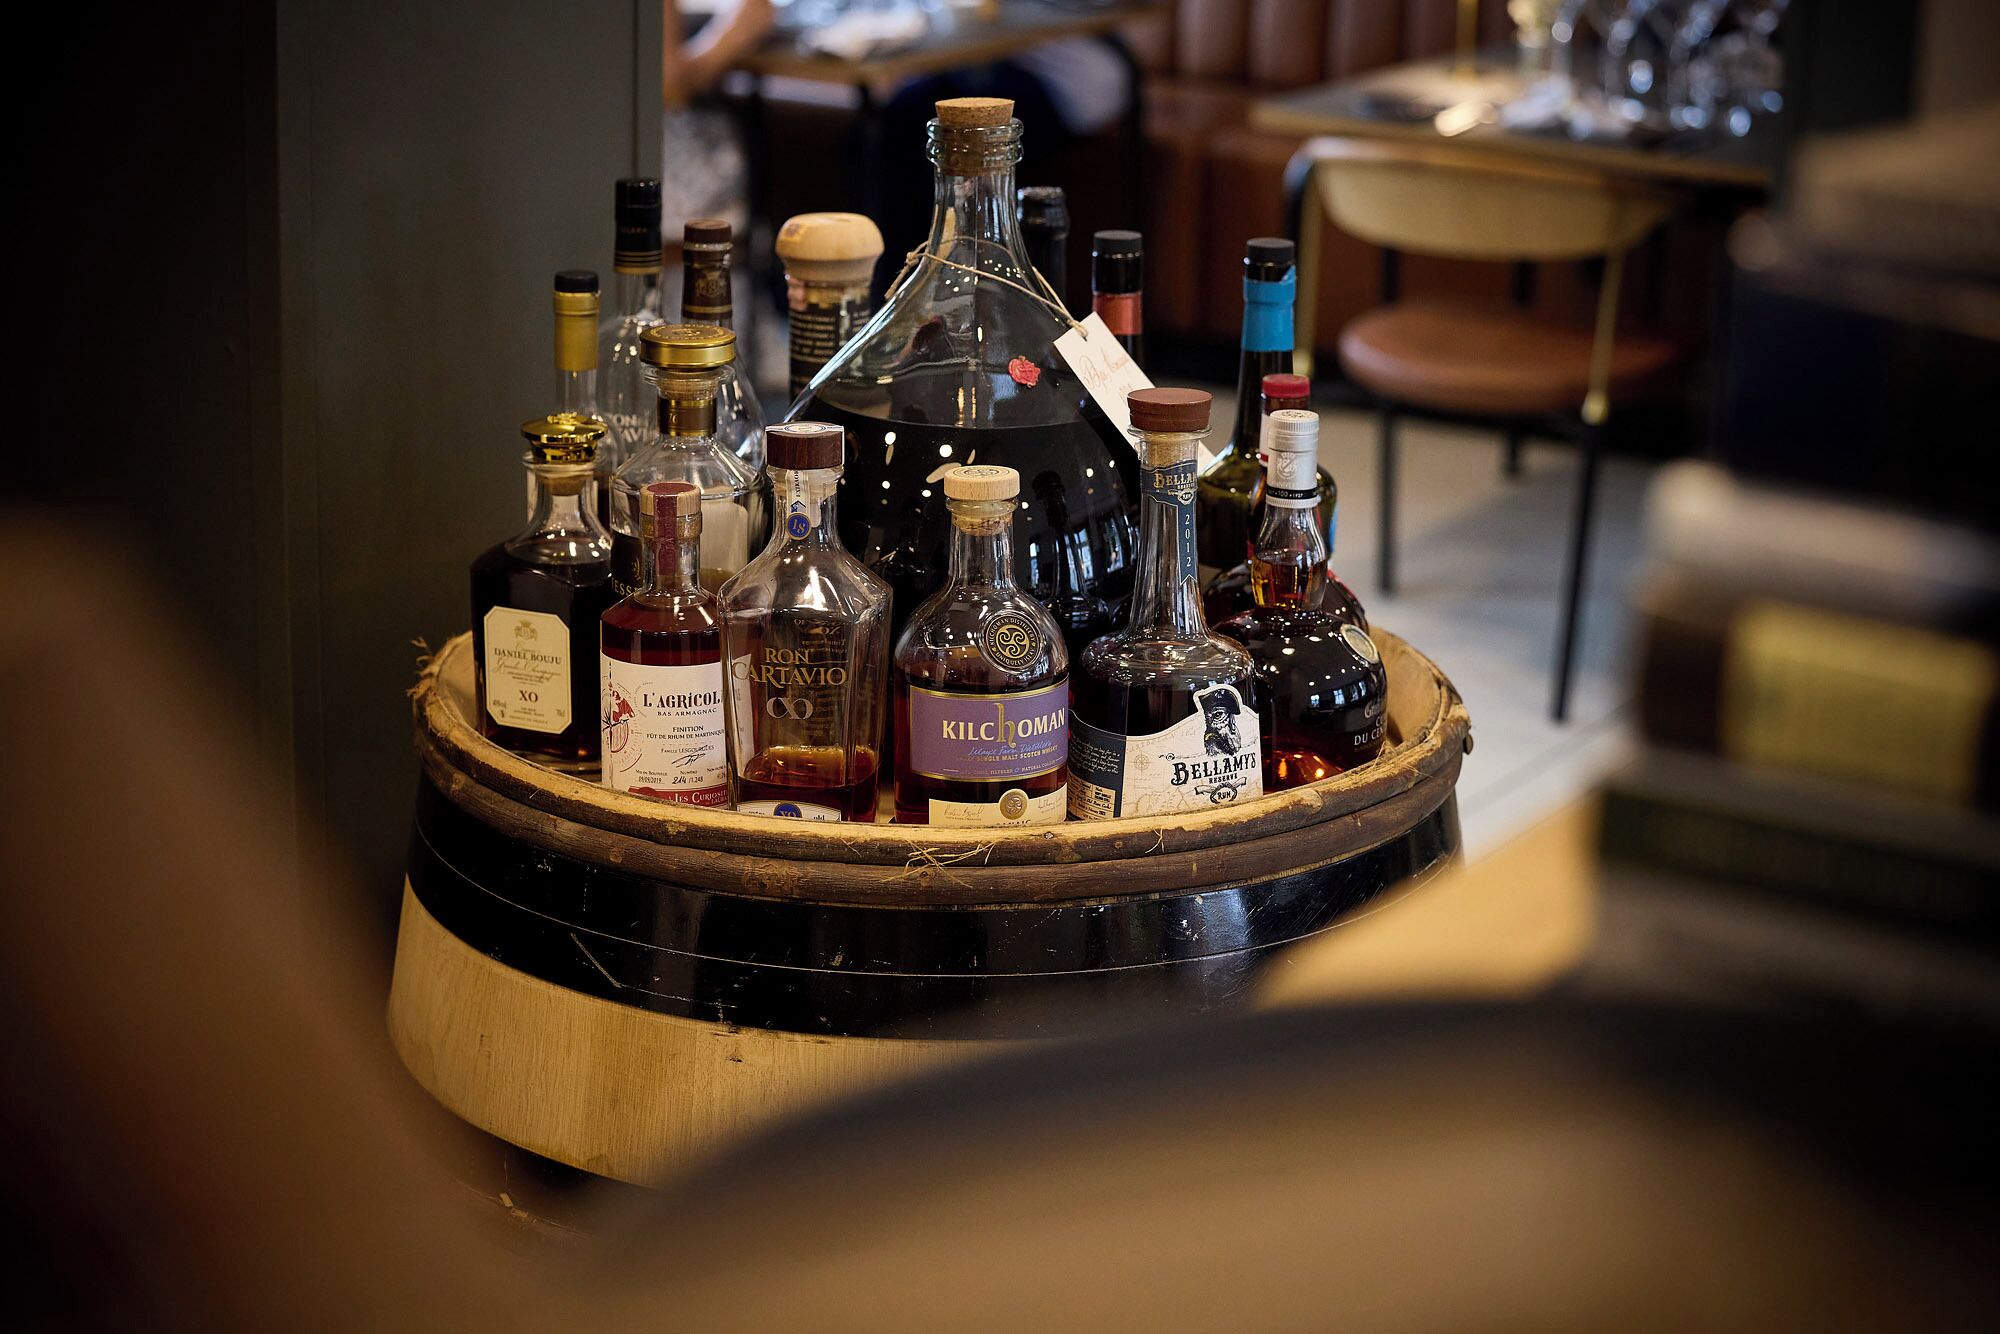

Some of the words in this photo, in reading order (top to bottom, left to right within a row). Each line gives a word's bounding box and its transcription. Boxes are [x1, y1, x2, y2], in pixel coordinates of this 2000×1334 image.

[494, 647, 528, 661] DANIEL
[530, 652, 562, 665] BOUJU
[765, 647, 815, 665] RON
[731, 661, 848, 689] CARTAVIO
[519, 689, 539, 703] XO
[675, 708, 717, 717] ARMAGNAC
[672, 725, 704, 733] FINITION
[1353, 732, 1369, 746] DU
[1020, 750, 1041, 759] SCOTCH
[1208, 772, 1238, 785] RESERVE
[1217, 790, 1231, 800] RUM
